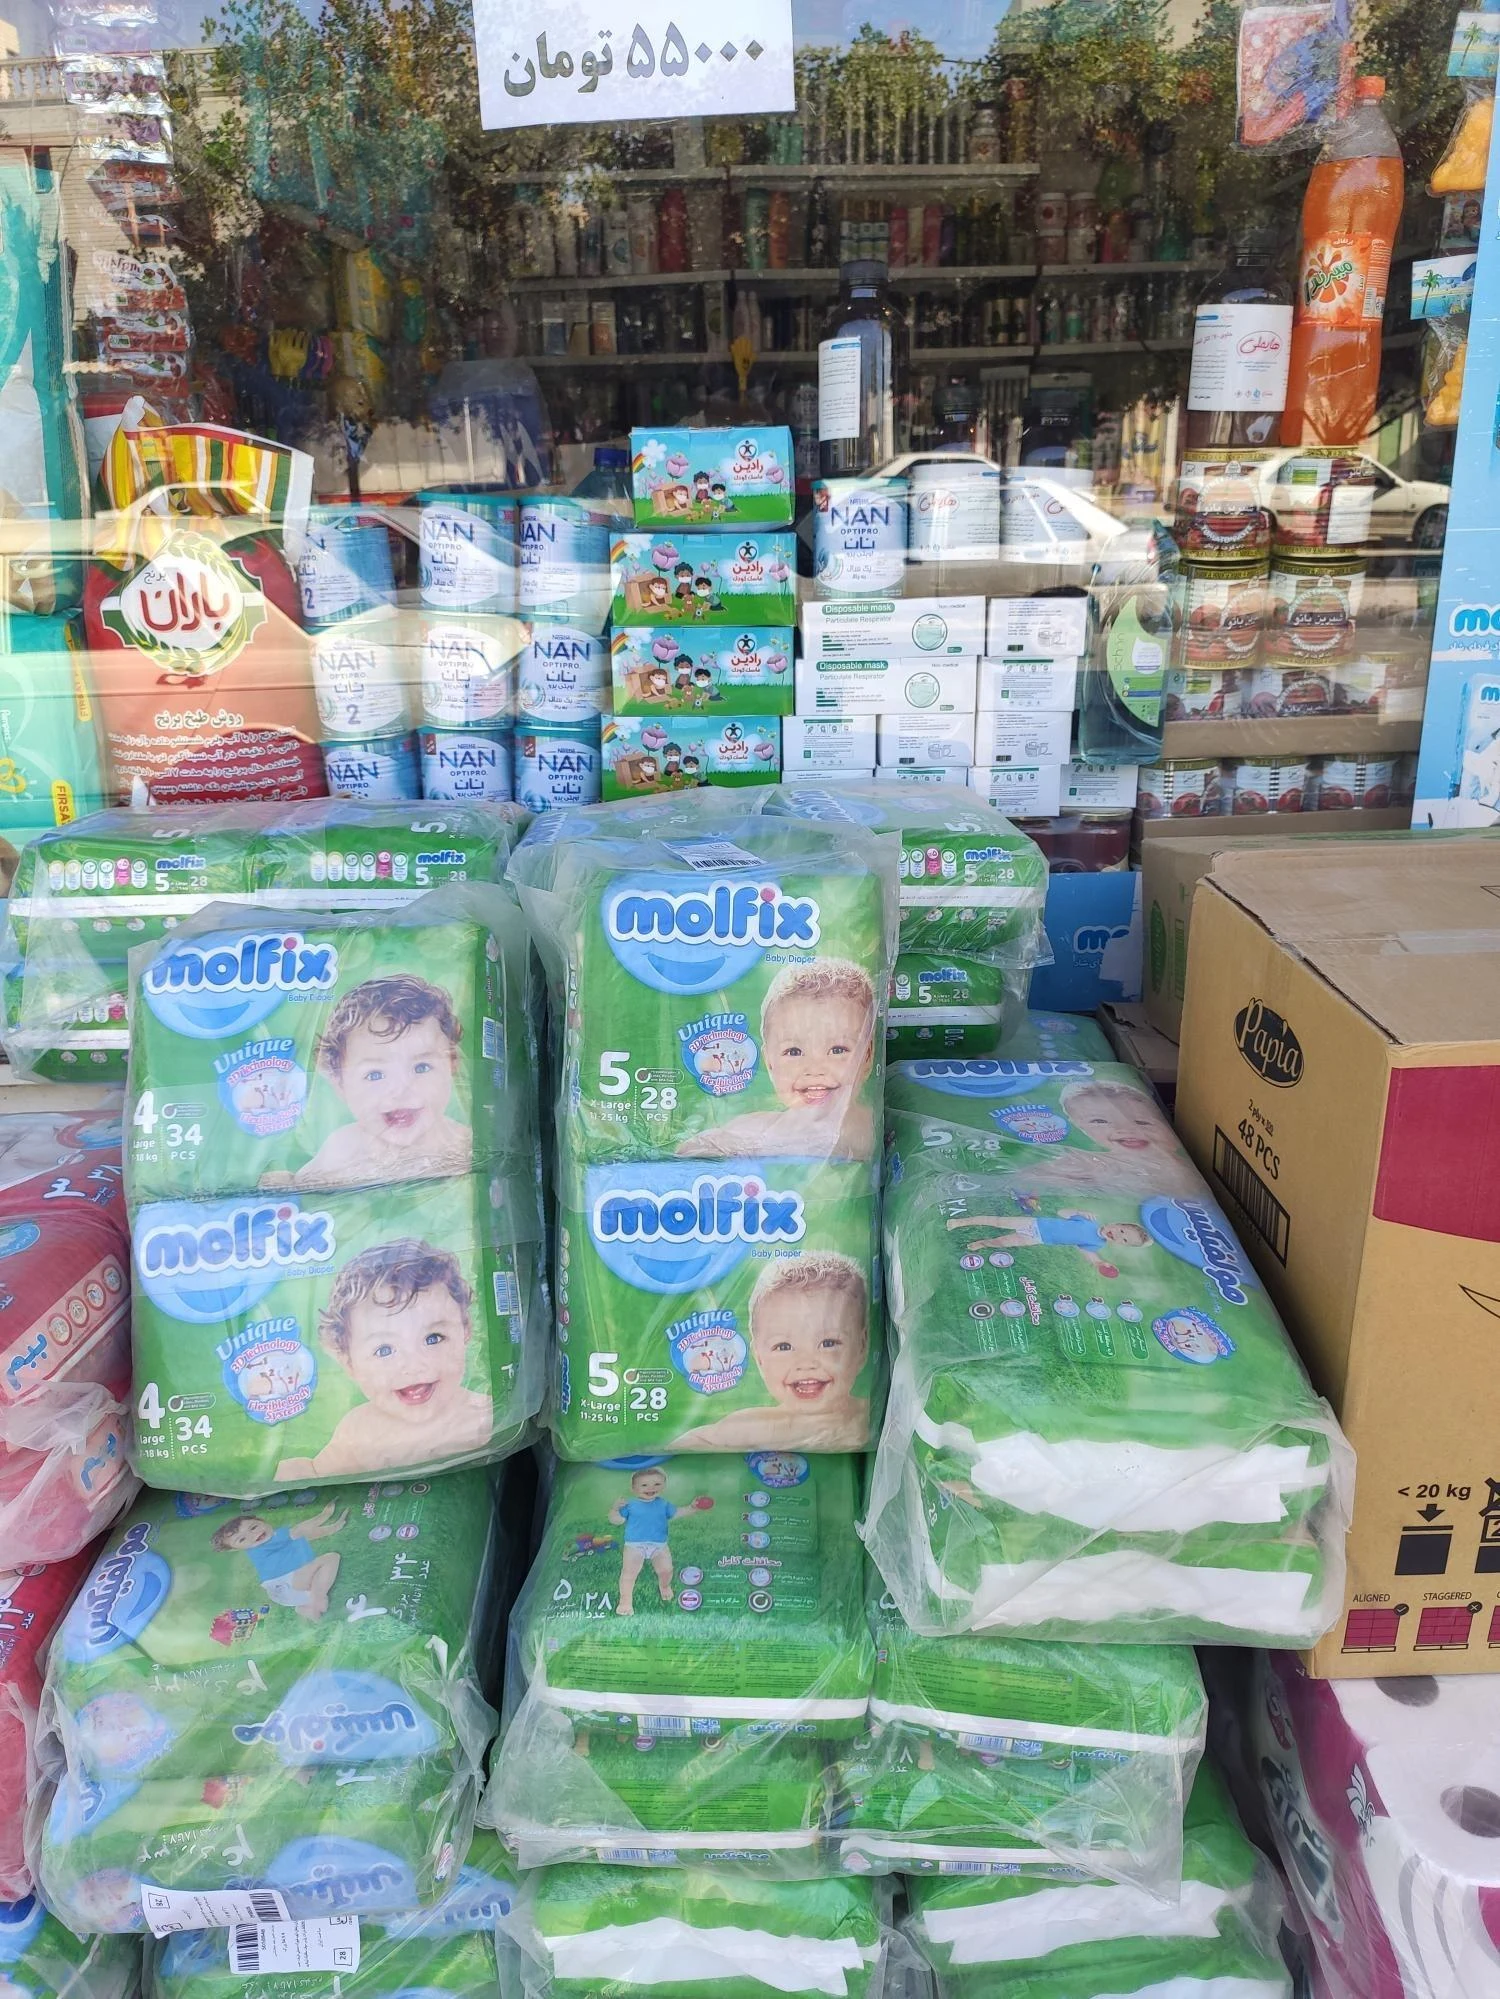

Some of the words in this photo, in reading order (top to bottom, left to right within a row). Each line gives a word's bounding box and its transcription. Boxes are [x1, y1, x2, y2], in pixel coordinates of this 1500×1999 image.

[626, 21, 764, 79] ۵۵۰۰۰
[504, 29, 613, 97] تومان
[1304, 262, 1353, 307] میرندا
[733, 460, 763, 475] رادین
[831, 507, 889, 526] NAN
[1202, 505, 1222, 517] بانو
[422, 521, 474, 542] NAN
[844, 536, 876, 549] نان
[432, 553, 458, 564] نان
[144, 568, 167, 584] برنج
[733, 561, 763, 576] رادین
[140, 571, 231, 632] باران
[305, 588, 315, 609] 2
[825, 605, 868, 615] Disposable
[1315, 613, 1344, 624] شیرین
[825, 616, 858, 624] Particulate
[860, 615, 892, 623] Respirator
[1293, 615, 1313, 626] بانو
[430, 638, 485, 660] NAN
[534, 641, 591, 661] NAN
[319, 650, 376, 672] NAN
[543, 661, 580, 669] OPTIPRO
[731, 653, 762, 668] رادین
[819, 662, 862, 671] Disposable
[865, 661, 887, 669] mask
[442, 670, 470, 681] نان
[546, 670, 576, 682] نان
[819, 673, 852, 681] Particulate
[334, 682, 364, 693] نان
[156, 711, 181, 728] برنج
[185, 710, 209, 728] طبخ
[213, 712, 243, 728] روش
[346, 704, 360, 724] 2
[238, 746, 266, 758] دقیقه
[719, 742, 749, 755] رادین
[439, 749, 496, 768] NAN
[538, 754, 593, 773] NAN
[329, 760, 379, 782] NAN
[454, 778, 485, 790] نان
[551, 782, 581, 794] نان
[56, 786, 71, 826] FIRSA
[156, 856, 206, 870] molfix
[417, 851, 465, 864] molfix
[190, 876, 208, 886] 28
[415, 867, 430, 886] 5
[450, 870, 467, 882] 28
[964, 864, 977, 883] 5
[998, 868, 1015, 880] 28
[155, 873, 170, 892] 5
[616, 886, 814, 941] molfix
[150, 935, 333, 989] molfix
[765, 953, 787, 966] Baby
[789, 953, 816, 966] Diaper
[919, 971, 966, 983] molfix
[288, 994, 308, 1003] Baby
[918, 986, 932, 1003] 5
[952, 988, 969, 1000] 28
[678, 1012, 745, 1043] Unique
[689, 1039, 702, 1054] 3D
[700, 1029, 748, 1045] Technology
[1239, 997, 1300, 1077] Papia
[213, 1037, 293, 1074] Unique
[241, 1057, 294, 1081] Technology
[599, 1051, 631, 1096] 5
[701, 1073, 731, 1088] Flexible
[714, 1081, 745, 1095] System
[590, 1099, 632, 1112] X-Large
[640, 1086, 678, 1111] 28
[133, 1091, 159, 1134] 4
[590, 1111, 613, 1122] 11-25
[615, 1112, 629, 1124] kg
[646, 1113, 669, 1122] PCS
[1249, 1098, 1254, 1112] 2
[1252, 1107, 1262, 1123] ply
[166, 1123, 203, 1147] 34
[254, 1117, 294, 1136] System
[967, 1139, 1001, 1151] 28
[1238, 1118, 1255, 1149] 48
[1255, 1134, 1280, 1180] PCS
[147, 1151, 158, 1163] kg
[170, 1150, 197, 1160] PCS
[43, 1178, 85, 1199] ۳
[600, 1181, 799, 1236] molfix
[946, 1198, 967, 1217] ۲۸
[146, 1206, 330, 1274] molfix
[751, 1249, 773, 1259] Baby
[775, 1249, 802, 1259] Diaper
[287, 1267, 307, 1279] Baby
[309, 1264, 335, 1276] Diaper
[665, 1310, 733, 1342] Unique
[215, 1317, 297, 1362] Unique
[677, 1338, 690, 1353] 3D
[687, 1327, 737, 1342] Technology
[232, 1357, 247, 1375] 3D
[245, 1338, 301, 1364] Technology
[588, 1352, 620, 1397] 5
[690, 1372, 720, 1385] Flexible
[703, 1379, 737, 1393] System
[138, 1382, 165, 1429] 4
[247, 1397, 287, 1414] Flexible
[286, 1386, 311, 1410] Body
[580, 1399, 621, 1413] X-Large
[629, 1387, 668, 1411] 28
[265, 1403, 305, 1424] System
[580, 1411, 603, 1423] 11-25
[606, 1411, 619, 1425] kg
[636, 1413, 660, 1422] PCS
[175, 1415, 213, 1441] 34
[156, 1448, 169, 1459] kg
[181, 1443, 208, 1455] PCS
[1415, 1484, 1440, 1499] 20
[1446, 1484, 1472, 1500] kg
[390, 1552, 417, 1580] ۳۴
[718, 1556, 742, 1567] کامل
[742, 1557, 782, 1567] محافظت
[86, 1522, 152, 1647] مولفیکس
[553, 1579, 572, 1600] ۵
[586, 1592, 612, 1611] ۲۸
[1353, 1594, 1391, 1603] ALIGNED
[1423, 1592, 1472, 1601] STAGGERED
[345, 1594, 388, 1623] ۴
[585, 1611, 606, 1619] عدد
[236, 1659, 268, 1696] ۴
[233, 1703, 416, 1754] مولفیکس
[222, 1823, 254, 1867] ۴
[339, 1950, 347, 1961] 28
